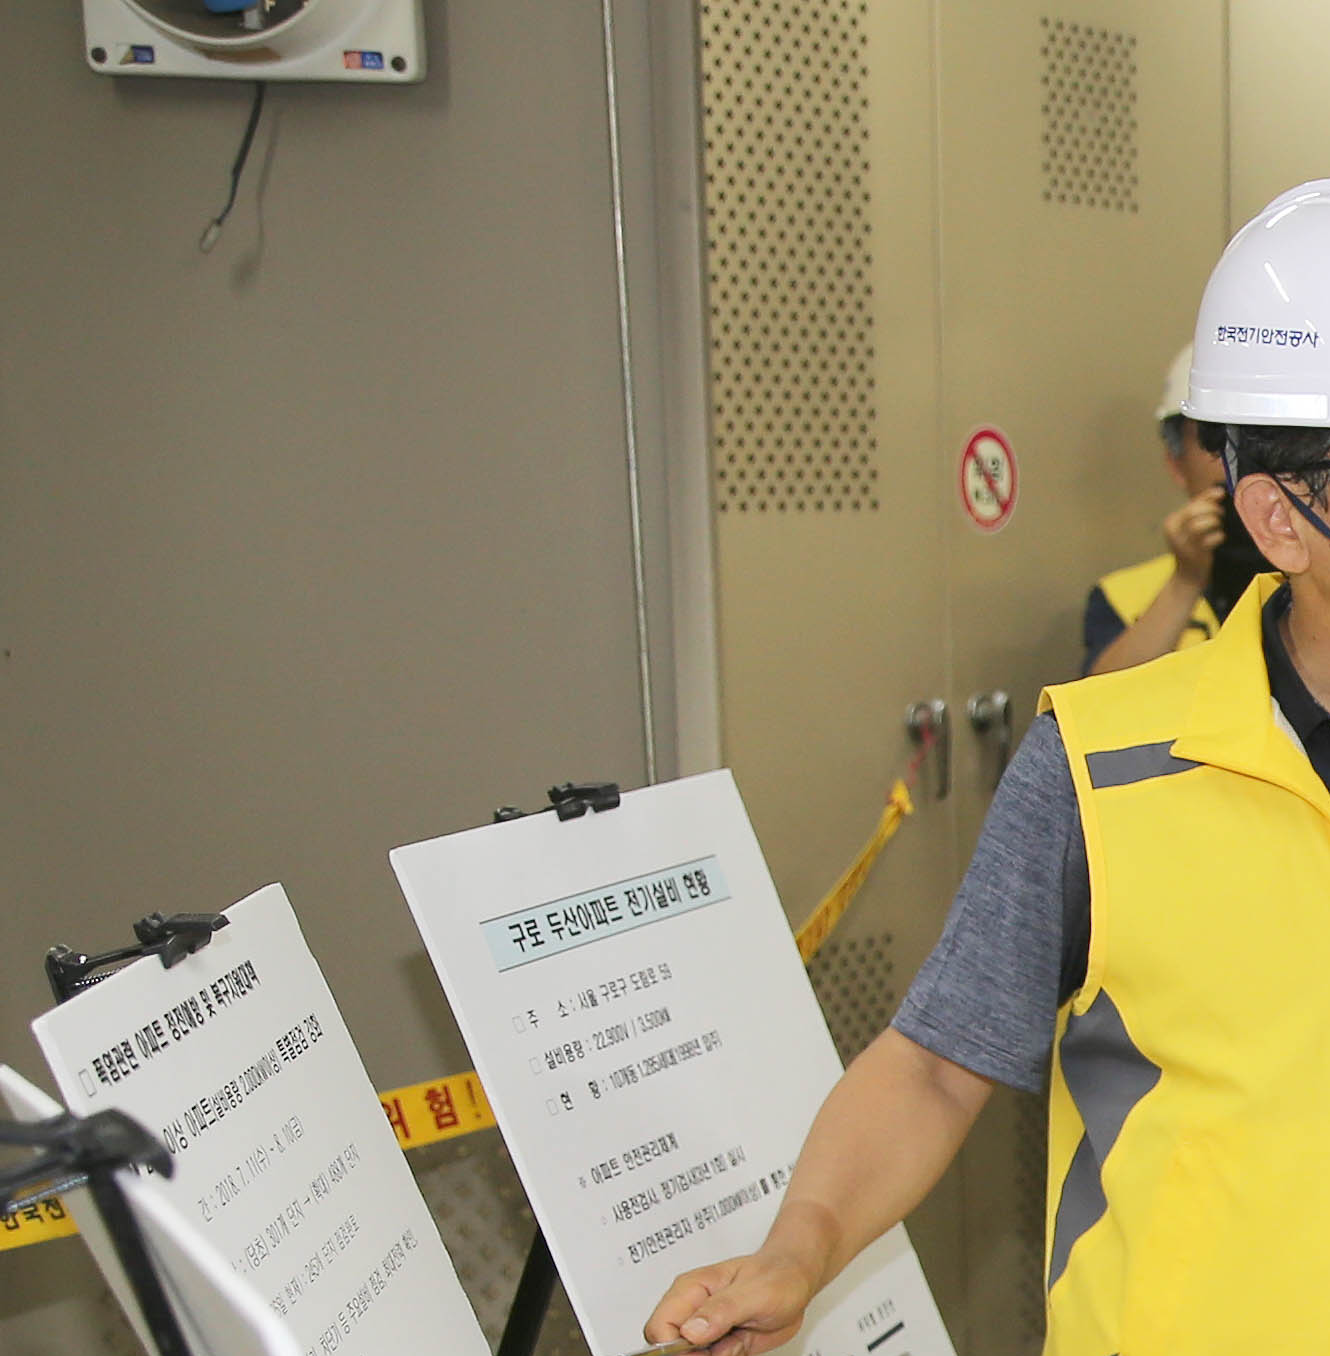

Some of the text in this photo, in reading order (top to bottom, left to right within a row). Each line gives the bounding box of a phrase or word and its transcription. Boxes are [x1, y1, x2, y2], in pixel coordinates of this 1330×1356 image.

[1218, 325, 1318, 348] 한국전기안전공사
[507, 868, 711, 952] 구로 두산아파트 전기설비 현황
[576, 989, 598, 1011] 서울
[598, 978, 629, 1001] 구로구
[92, 1038, 139, 1086] 폭염관련
[134, 1020, 170, 1060] 아파트
[163, 996, 204, 1041] 정전예방
[543, 1040, 585, 1070] 설비용량
